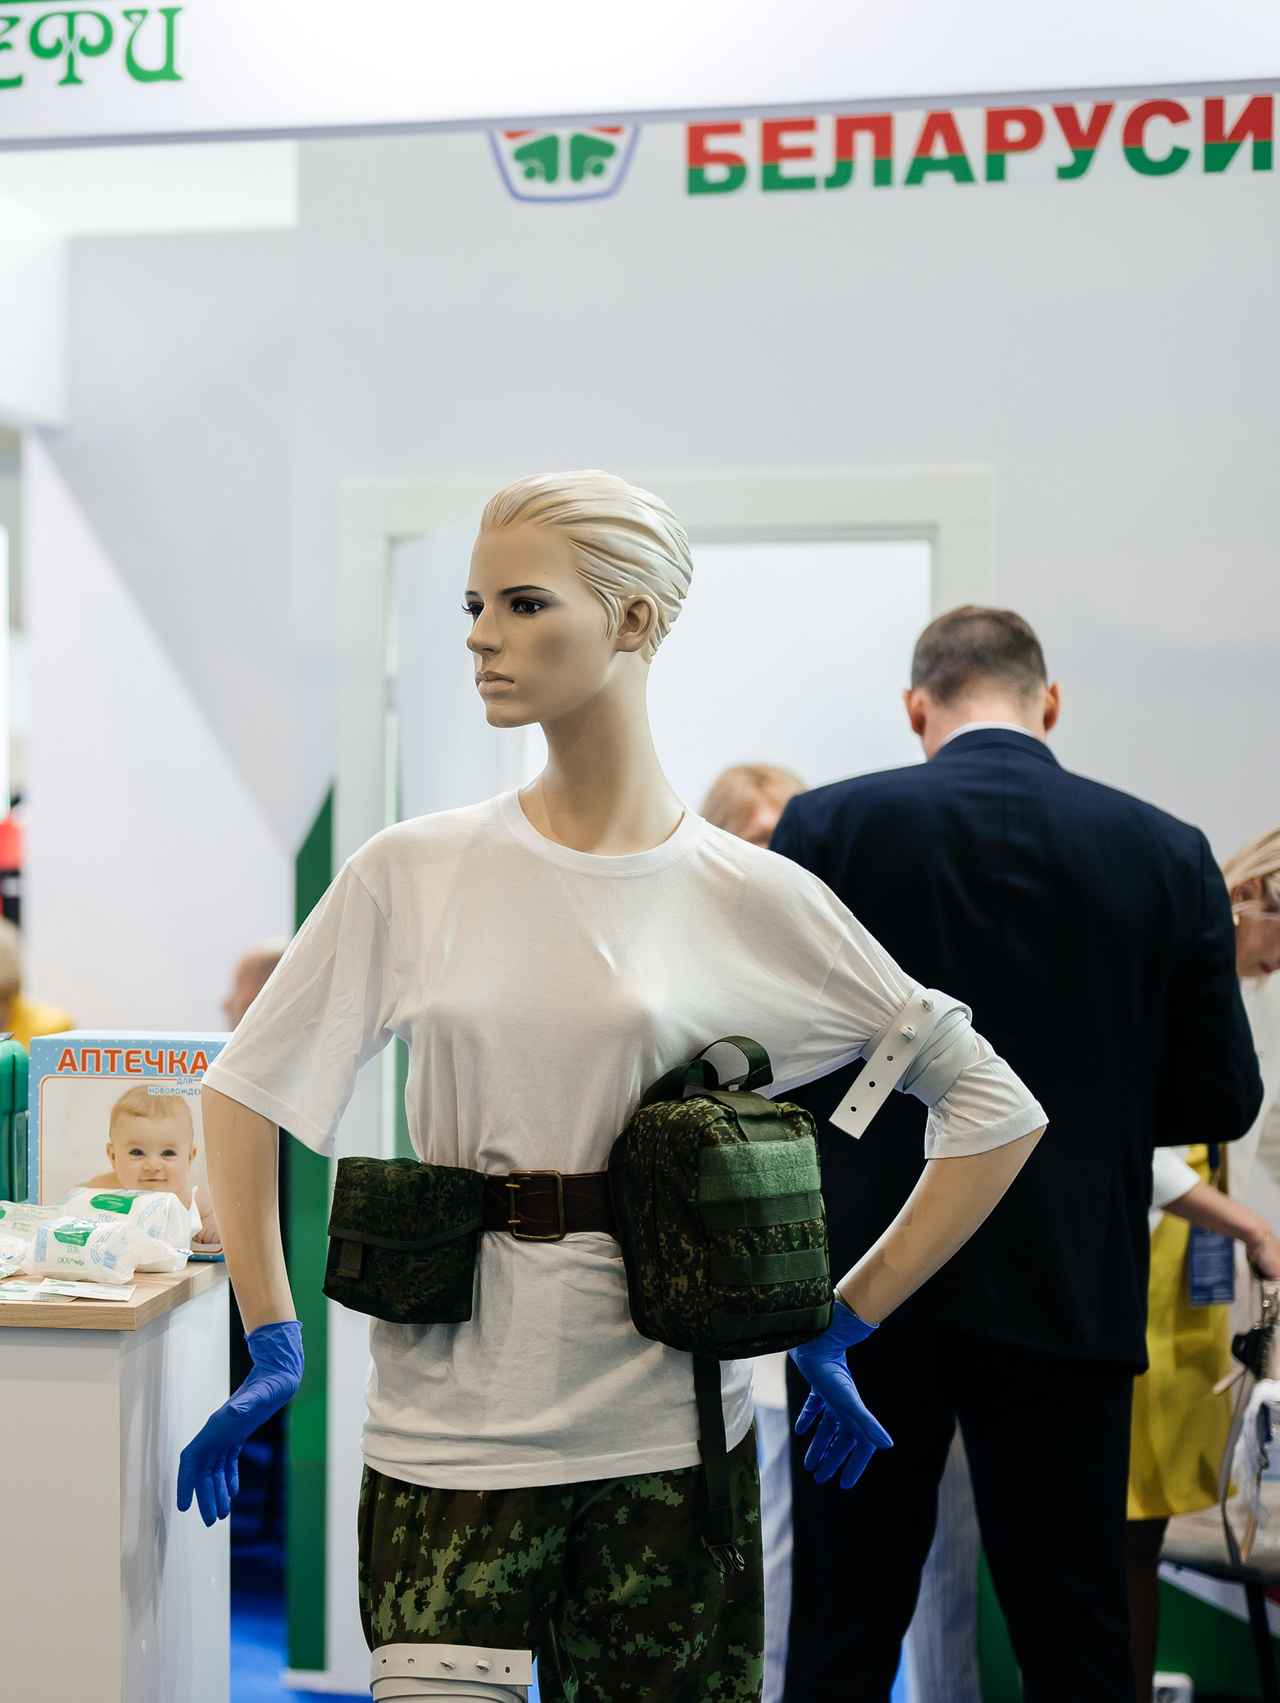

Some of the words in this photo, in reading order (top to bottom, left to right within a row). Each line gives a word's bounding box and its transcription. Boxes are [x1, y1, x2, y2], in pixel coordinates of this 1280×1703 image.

[686, 93, 1275, 196] БЕЛАРУСИ
[56, 1047, 209, 1075] АПТЕЧКА
[176, 1077, 193, 1085] ДЛЯ
